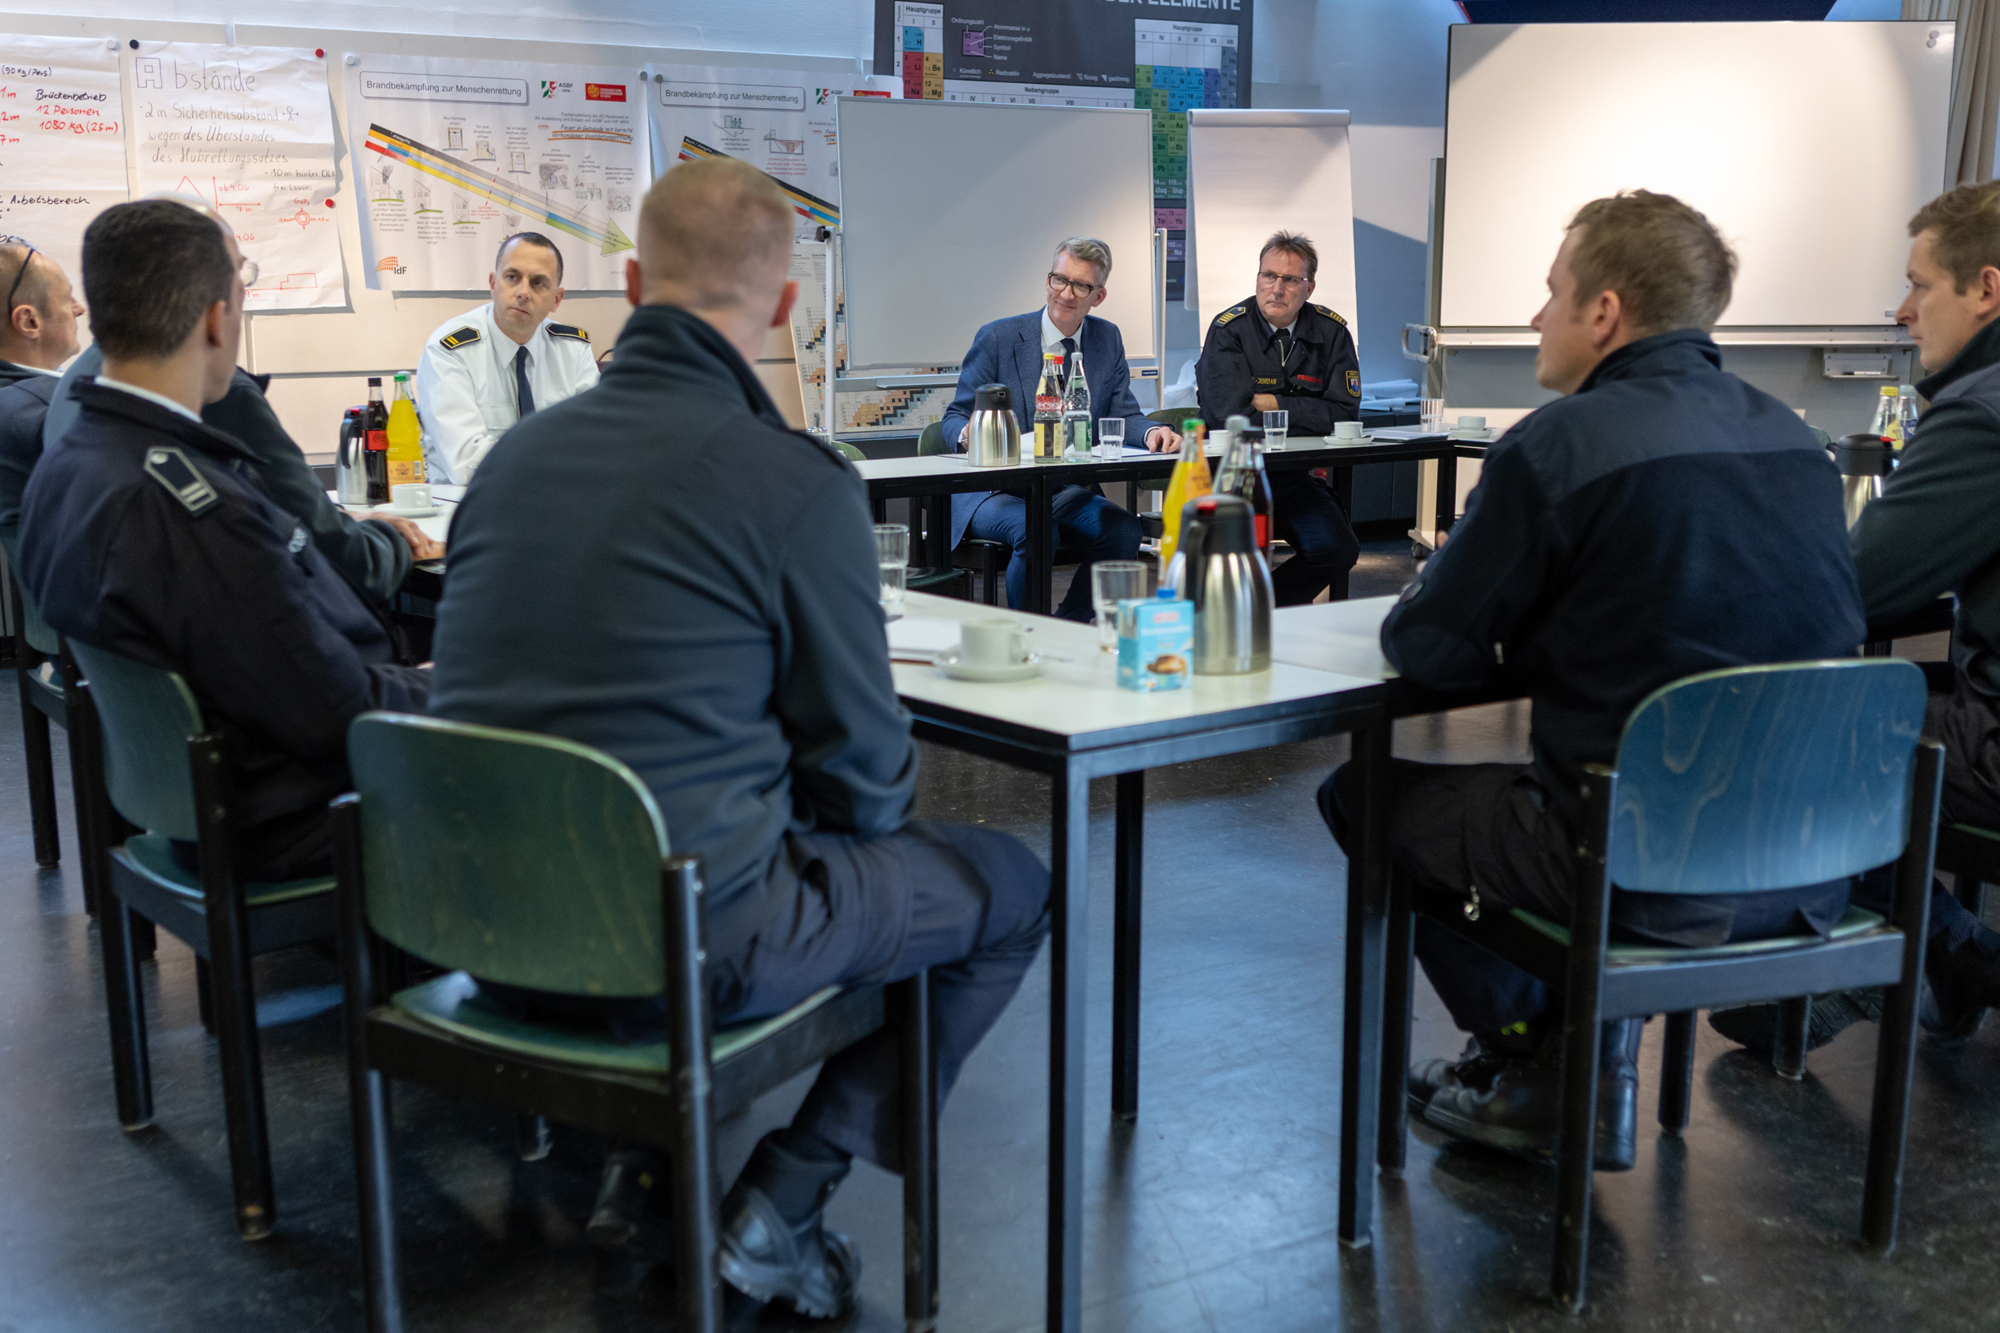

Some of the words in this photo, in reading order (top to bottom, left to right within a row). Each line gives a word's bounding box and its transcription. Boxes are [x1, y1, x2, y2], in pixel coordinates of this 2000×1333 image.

[906, 6, 941, 14] Hauptgruppe
[366, 80, 440, 93] Brandbekämpfung
[456, 85, 522, 97] Menschenrettung
[932, 89, 942, 97] Mg
[666, 89, 728, 101] Brandbekämpfung
[742, 92, 798, 103] Menschenrettung
[36, 105, 49, 114] 12
[54, 105, 100, 116] Personen
[39, 120, 66, 130] 1080
[148, 131, 180, 148] wegen
[183, 126, 202, 142] des
[152, 147, 172, 163] des
[296, 169, 318, 178] hinter
[10, 195, 90, 205] Arbeitsbereich
